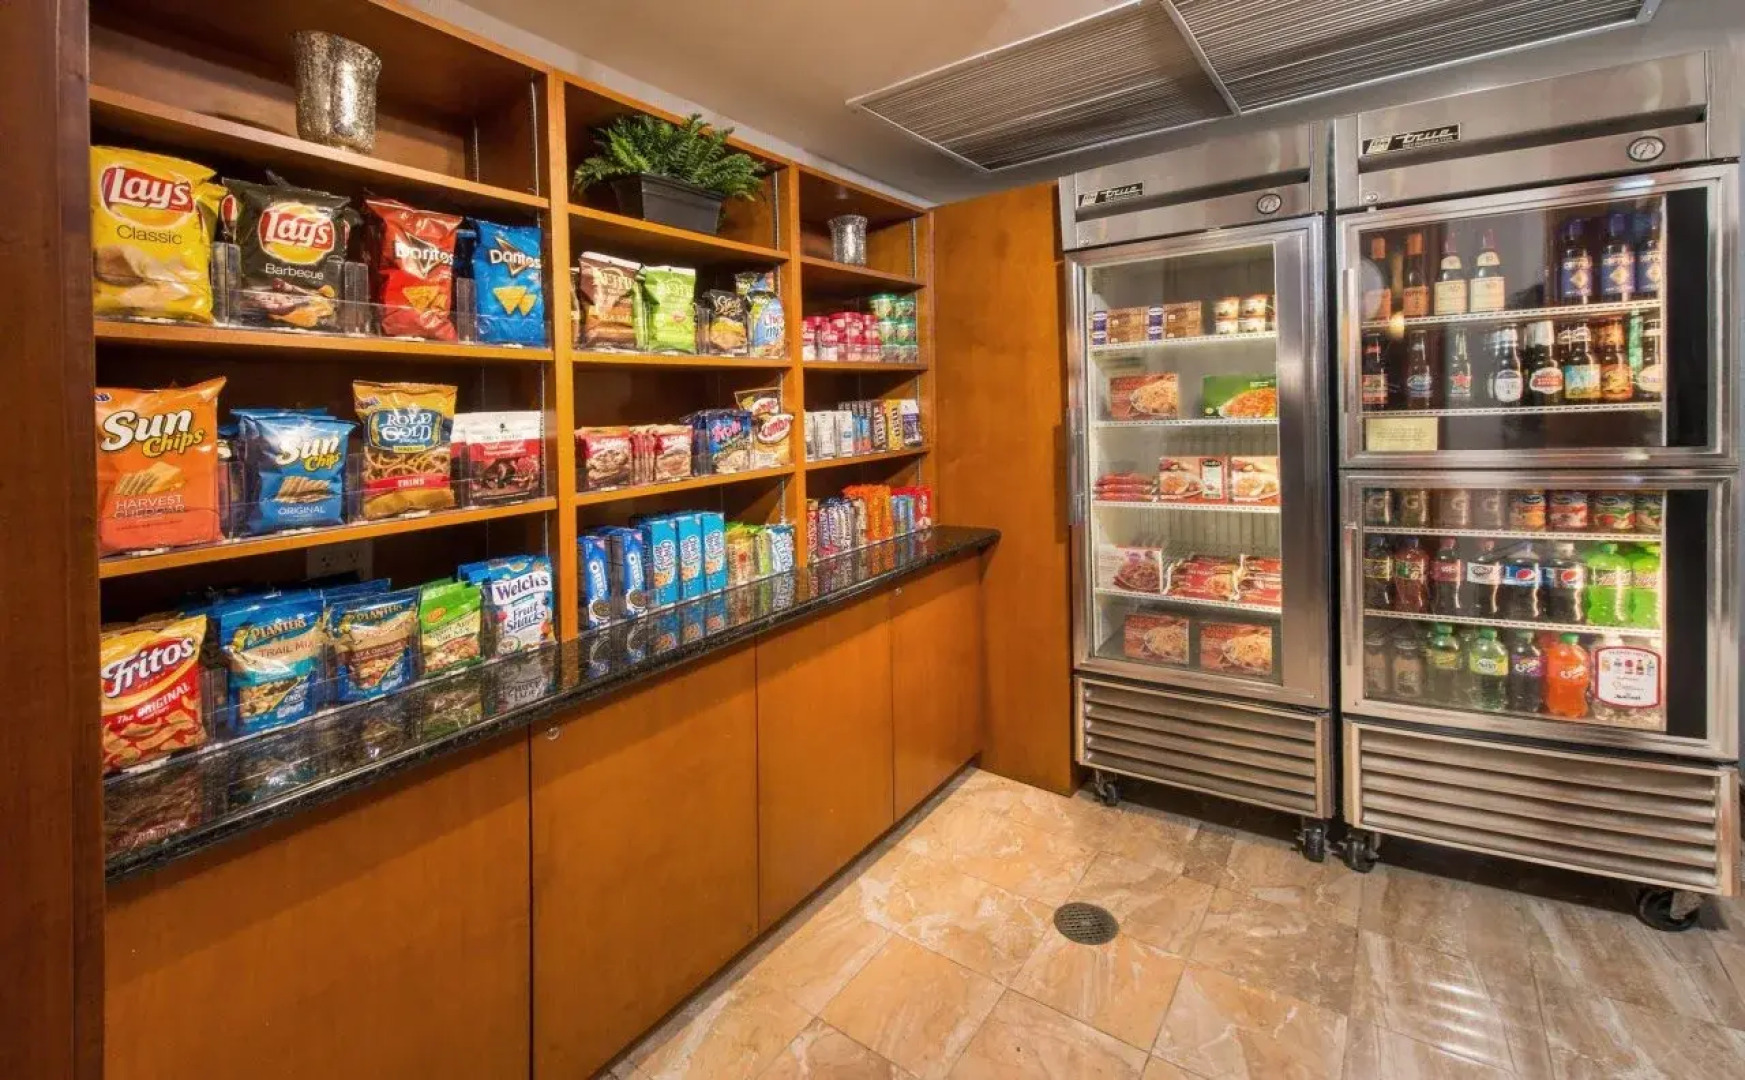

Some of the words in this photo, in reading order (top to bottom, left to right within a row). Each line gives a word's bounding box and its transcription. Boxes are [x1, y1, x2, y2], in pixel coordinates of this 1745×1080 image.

[116, 224, 182, 245] Classic
[394, 241, 453, 265] Doritos
[265, 262, 324, 280] Barbecue
[386, 412, 432, 426] ROLD
[100, 409, 192, 452] Sun
[381, 425, 432, 441] GOLD
[142, 429, 204, 458] Chips
[275, 437, 339, 465] Sun
[115, 494, 184, 510] HARVEST
[277, 504, 326, 515] ORIGINAL
[258, 645, 293, 657] TRAIL
[101, 637, 195, 698] Fritos
[117, 714, 134, 724] The
